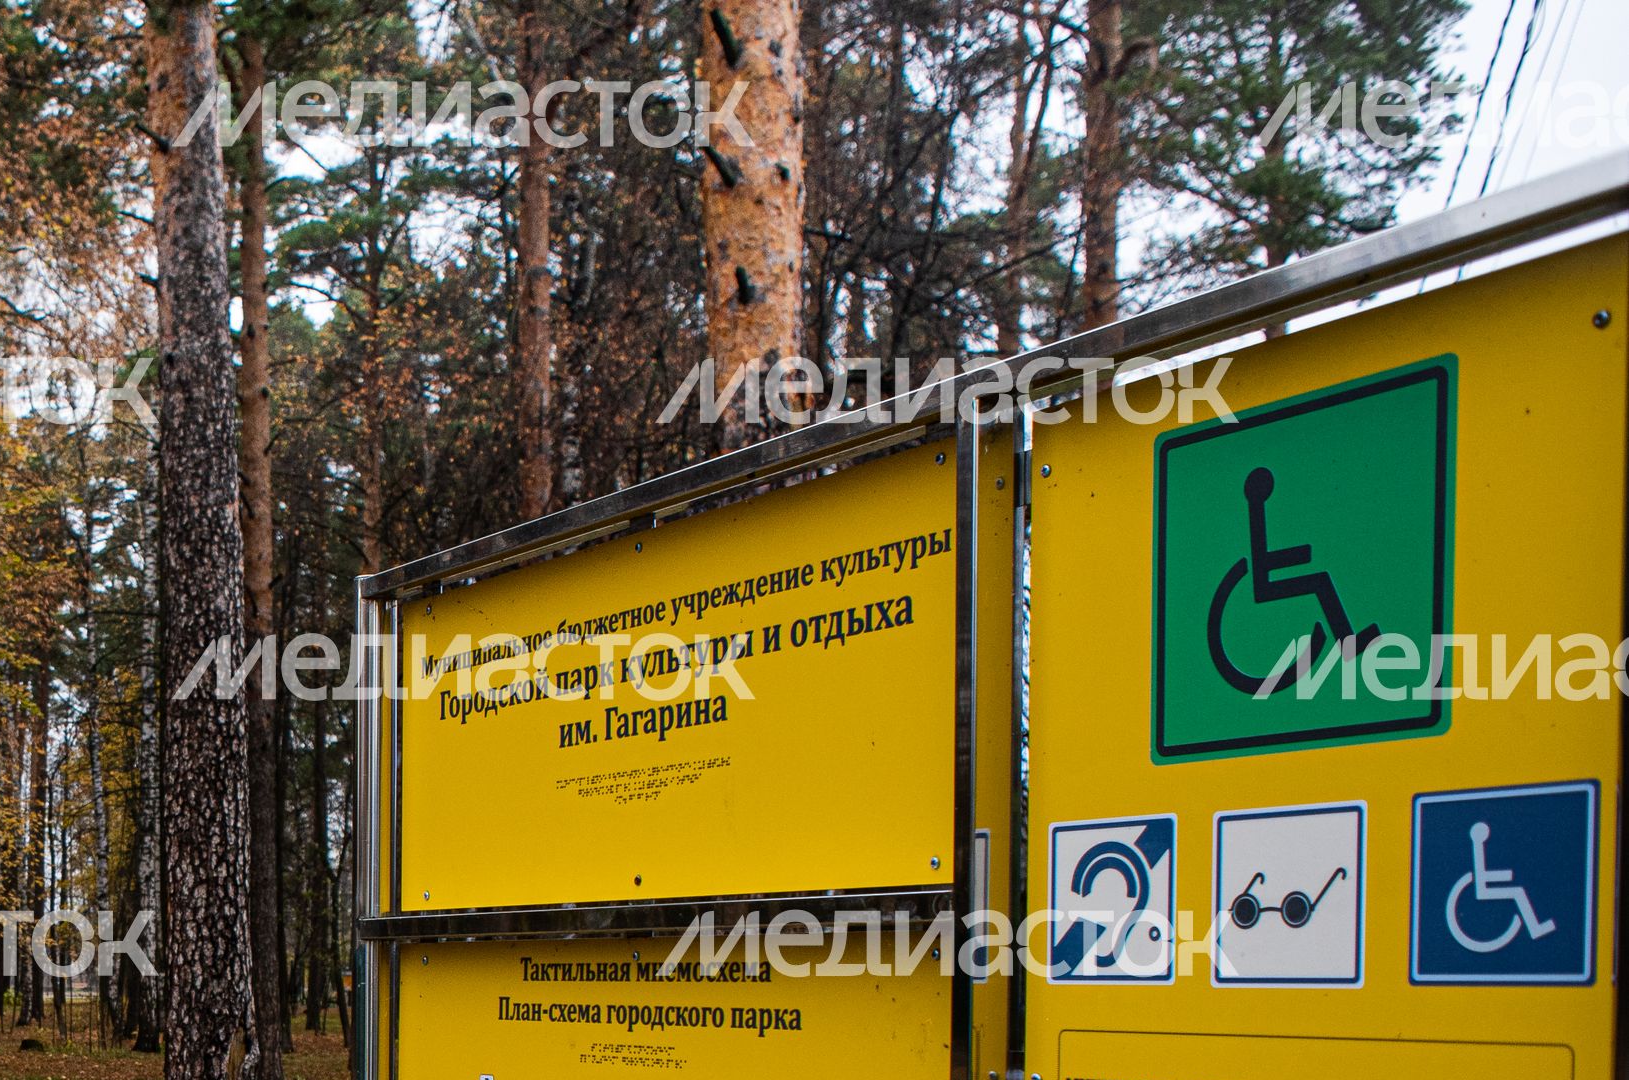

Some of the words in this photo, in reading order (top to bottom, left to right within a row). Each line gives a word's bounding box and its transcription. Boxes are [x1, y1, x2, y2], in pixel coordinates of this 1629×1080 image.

[421, 630, 552, 682] Муниципальное
[557, 600, 666, 645] бюджетное
[671, 563, 814, 625] учреждение
[821, 528, 951, 586] культуры
[440, 667, 549, 724] Городской
[556, 660, 614, 700] парк
[621, 630, 754, 689] культуры
[762, 624, 781, 653] и
[791, 594, 914, 649] отдыха
[559, 719, 598, 748] им.
[605, 695, 728, 741] Гагарина
[521, 957, 631, 983] Тактильная
[636, 960, 771, 983] мнемосхема
[498, 996, 601, 1024] План-схема
[606, 1003, 724, 1032] городского
[730, 1006, 802, 1037] парка
